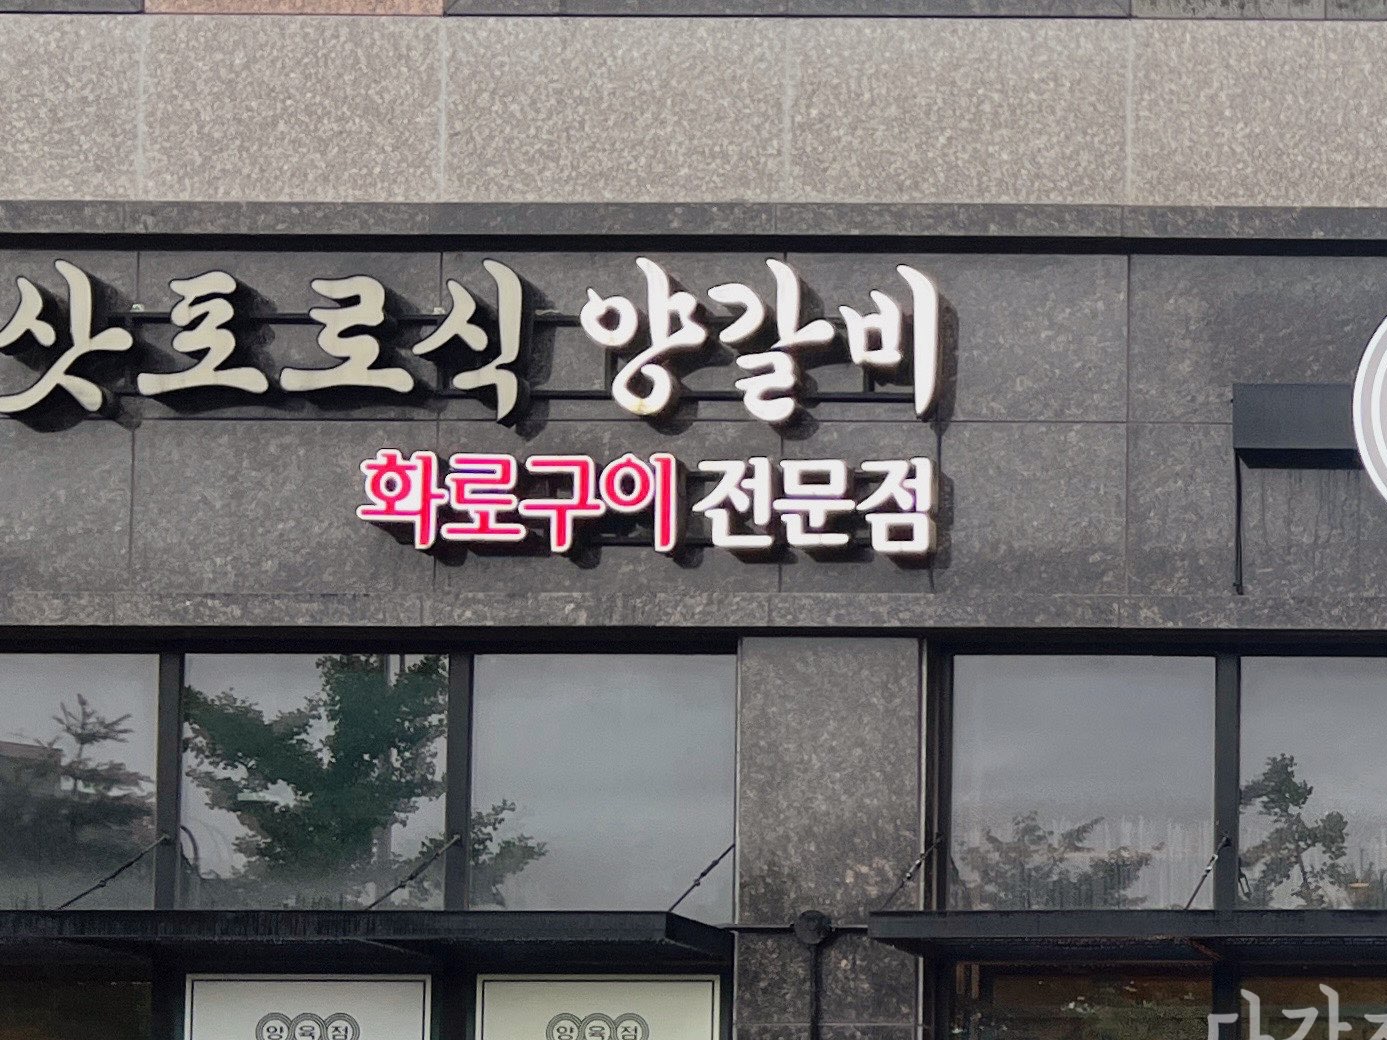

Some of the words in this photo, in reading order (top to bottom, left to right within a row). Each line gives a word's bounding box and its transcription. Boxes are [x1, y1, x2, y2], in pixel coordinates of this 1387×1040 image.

[580, 257, 938, 421] 양갈비
[356, 449, 678, 551] 화로구이
[692, 457, 934, 553] 전문점
[266, 1025, 349, 1040] 양육점
[556, 1025, 638, 1040] 양육점
